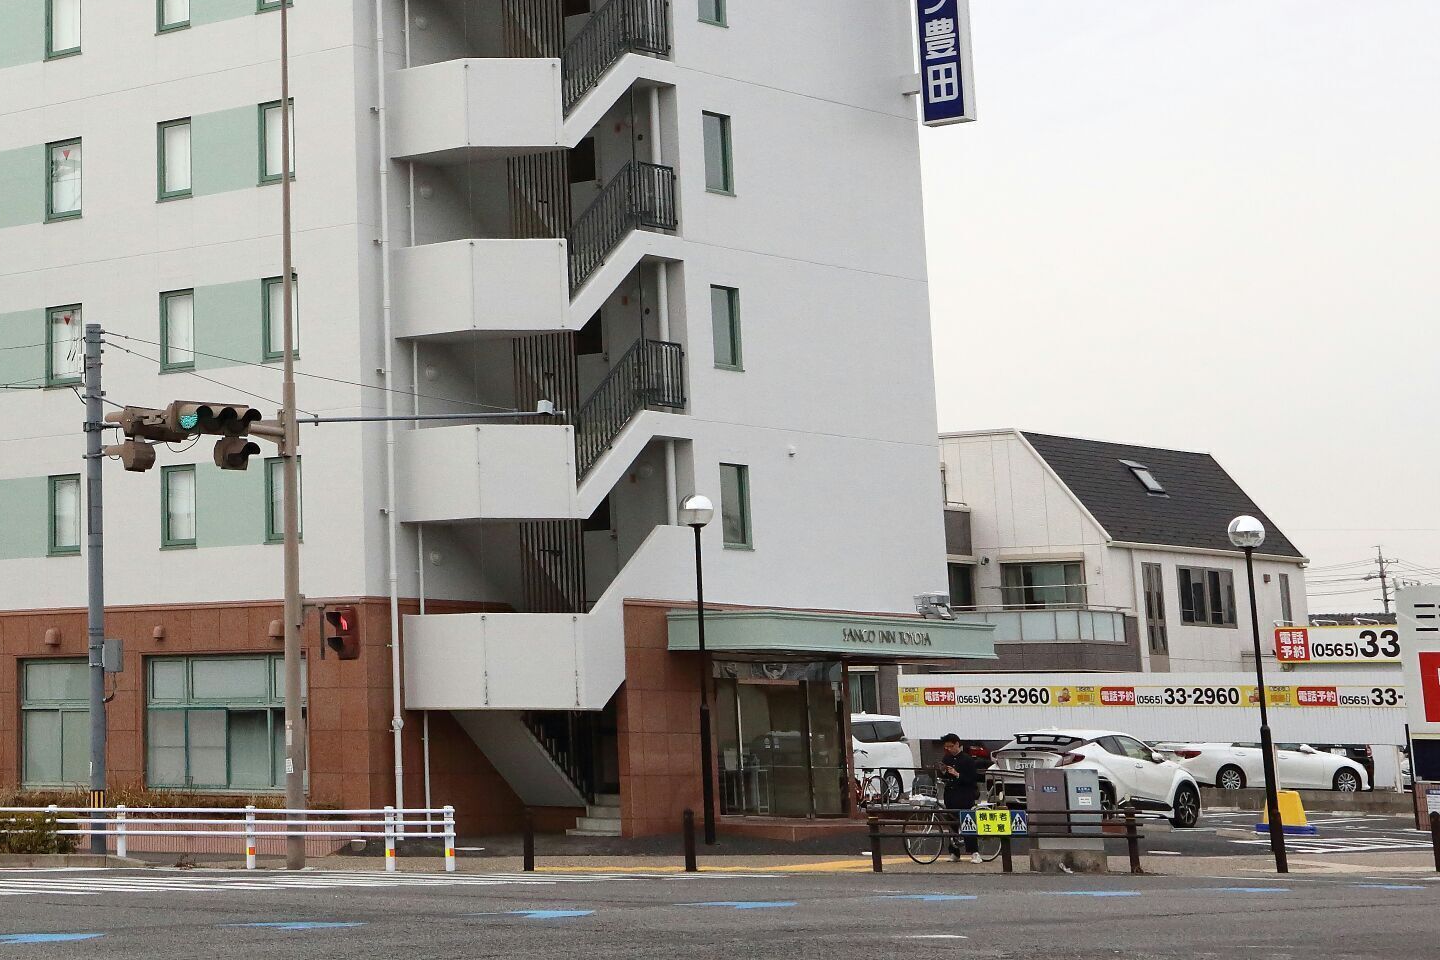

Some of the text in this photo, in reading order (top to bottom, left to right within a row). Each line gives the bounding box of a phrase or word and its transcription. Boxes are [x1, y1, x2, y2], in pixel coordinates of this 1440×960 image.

[1414, 603, 1440, 632] 三
[842, 628, 932, 646] SANCO INN TOYOTA
[1279, 631, 1304, 645] 電話
[1311, 629, 1401, 658] (0565) 33
[1281, 645, 1306, 659] 予約
[924, 691, 955, 702] 電話予約
[957, 695, 981, 704] (0565)
[981, 688, 1050, 704] 33-2960
[1101, 691, 1135, 702] 電話予約
[1137, 695, 1163, 704] (0565)
[1164, 687, 1240, 705] 33-2960
[1298, 691, 1336, 703] 電話予約
[1339, 695, 1370, 705] (0565)
[1371, 688, 1406, 706] 33-
